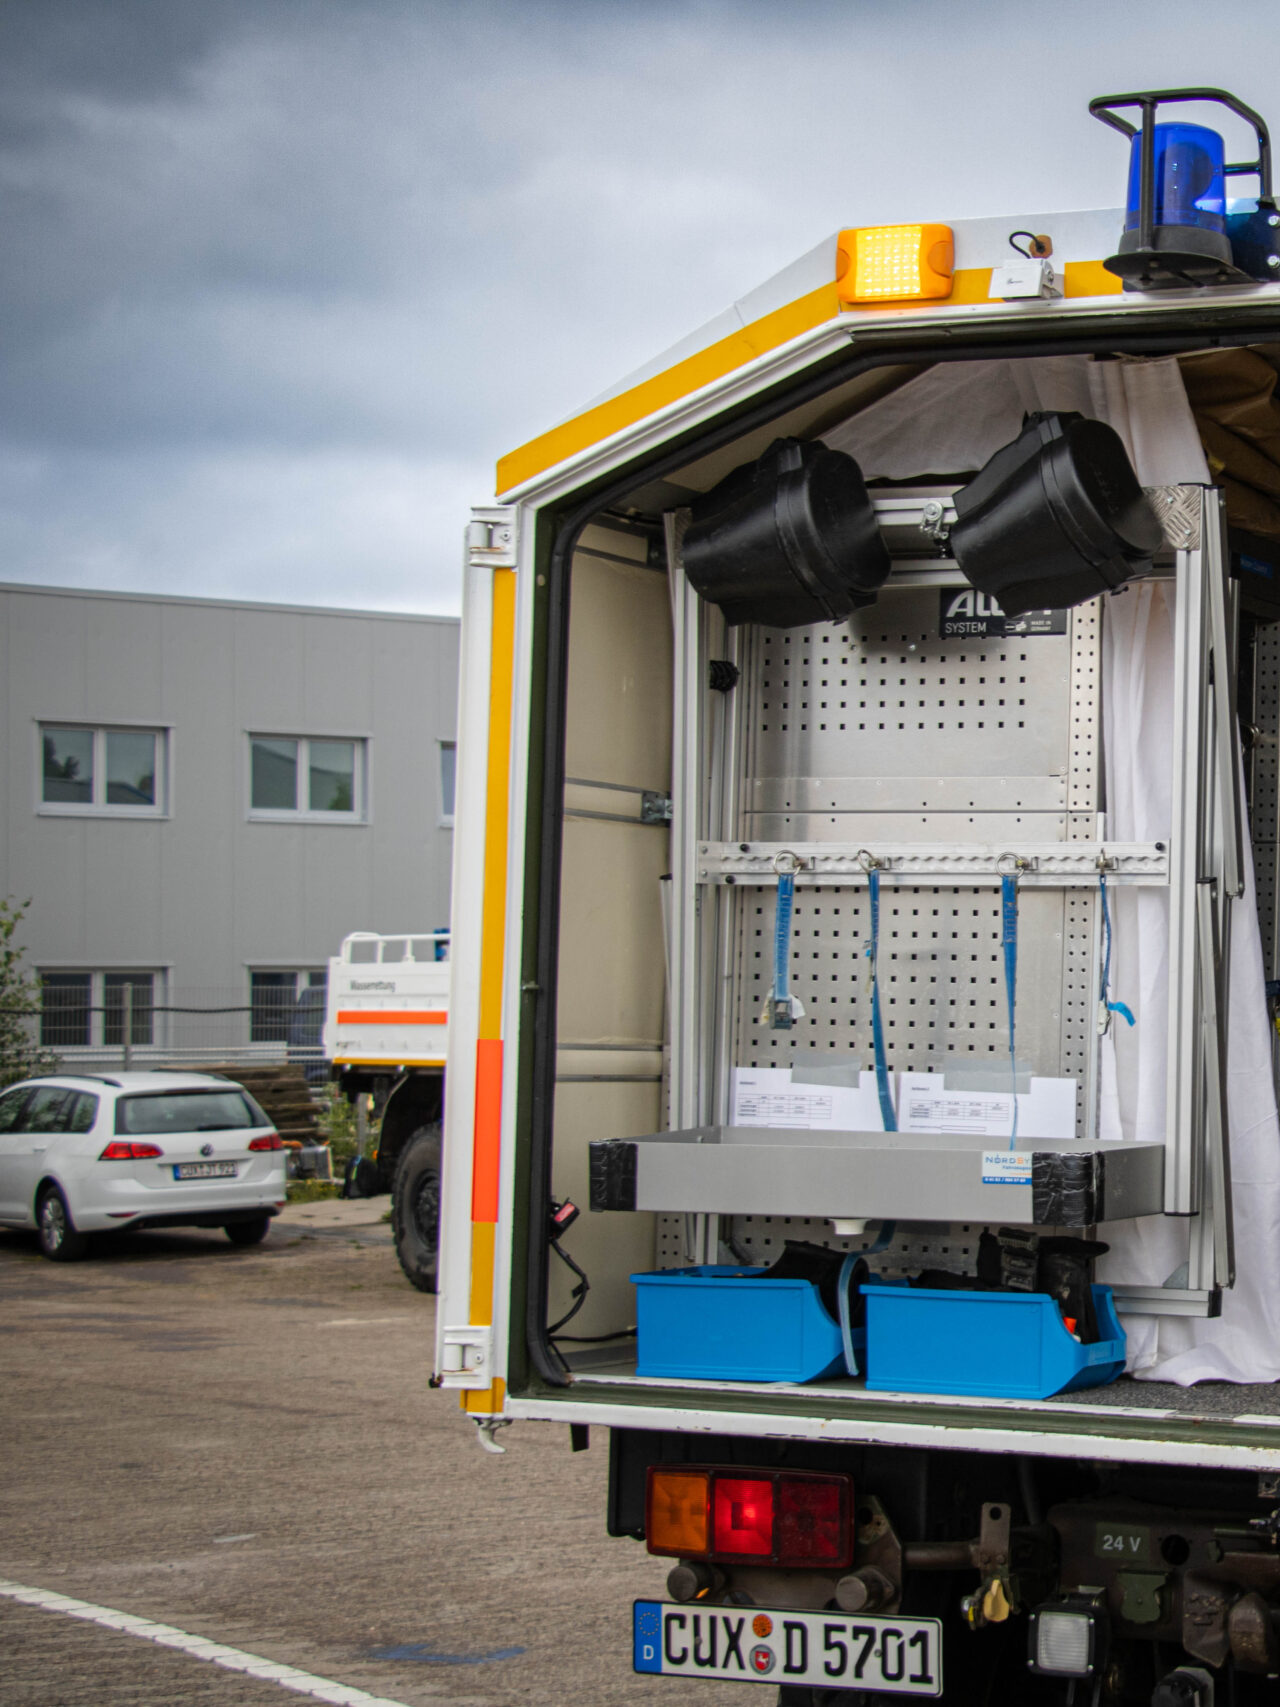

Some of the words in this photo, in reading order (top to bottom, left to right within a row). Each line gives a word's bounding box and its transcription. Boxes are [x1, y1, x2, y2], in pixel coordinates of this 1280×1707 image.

[945, 622, 987, 634] SYSTEM
[1103, 1534, 1124, 1550] 24
[1129, 1536, 1141, 1552] V
[643, 1645, 654, 1660] D
[664, 1612, 746, 1671] CUX
[783, 1620, 809, 1675] D
[823, 1622, 935, 1685] 5701
